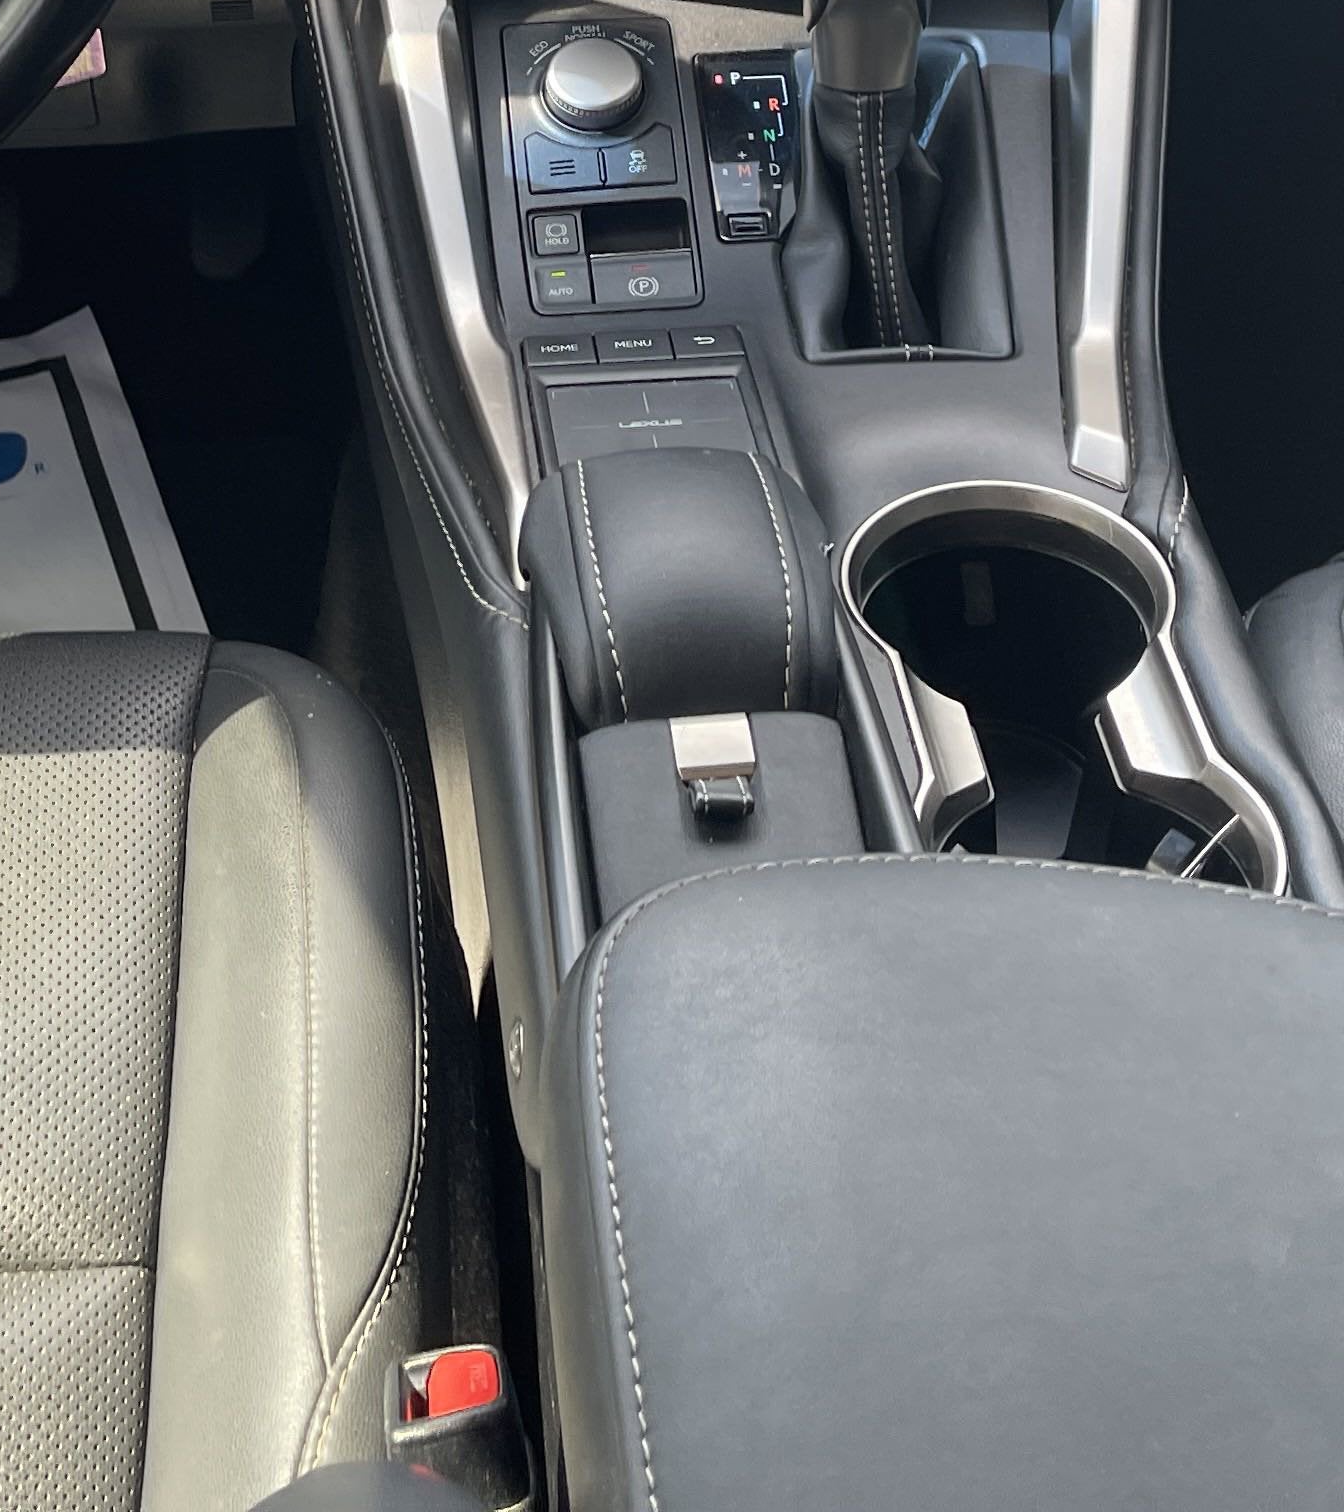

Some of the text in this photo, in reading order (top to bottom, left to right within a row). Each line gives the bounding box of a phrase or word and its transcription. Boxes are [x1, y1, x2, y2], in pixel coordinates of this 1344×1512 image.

[571, 24, 600, 34] PUSH
[623, 30, 656, 51] SPORT
[529, 40, 549, 57] ECO
[729, 71, 741, 85] P
[768, 97, 780, 112] R
[763, 128, 776, 143] N
[628, 162, 648, 174] OFF
[738, 164, 752, 178] M
[769, 162, 781, 177] D
[544, 235, 570, 247] HOLD
[548, 286, 574, 297] AUTO
[540, 342, 579, 354] HOME
[614, 338, 653, 349] MENU
